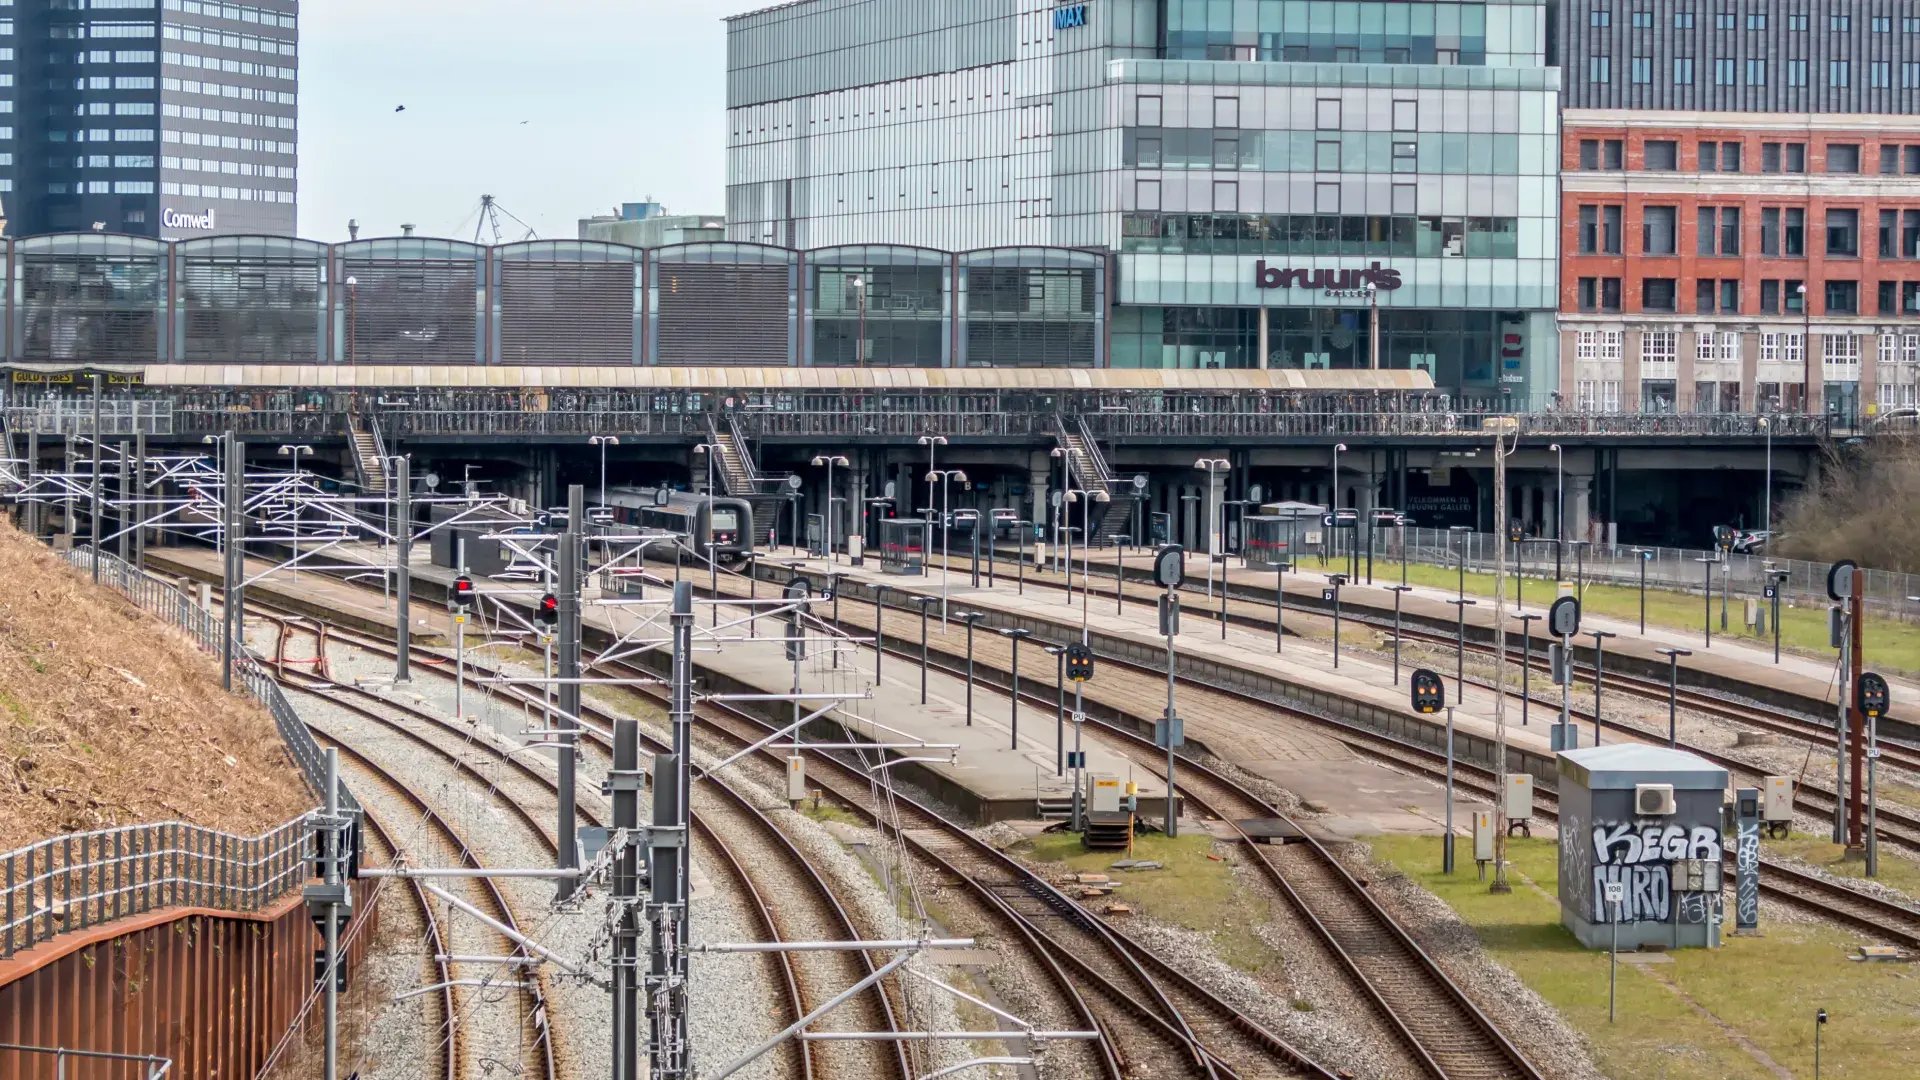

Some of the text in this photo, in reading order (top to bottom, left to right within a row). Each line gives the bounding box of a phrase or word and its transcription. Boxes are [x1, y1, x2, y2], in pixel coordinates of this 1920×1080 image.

[163, 208, 214, 229] Comwell
[1325, 290, 1376, 298] GALLER
[964, 481, 971, 490] B
[1324, 515, 1332, 526] C
[1325, 592, 1332, 600] D
[1766, 589, 1773, 597] D
[1073, 713, 1084, 721] PU
